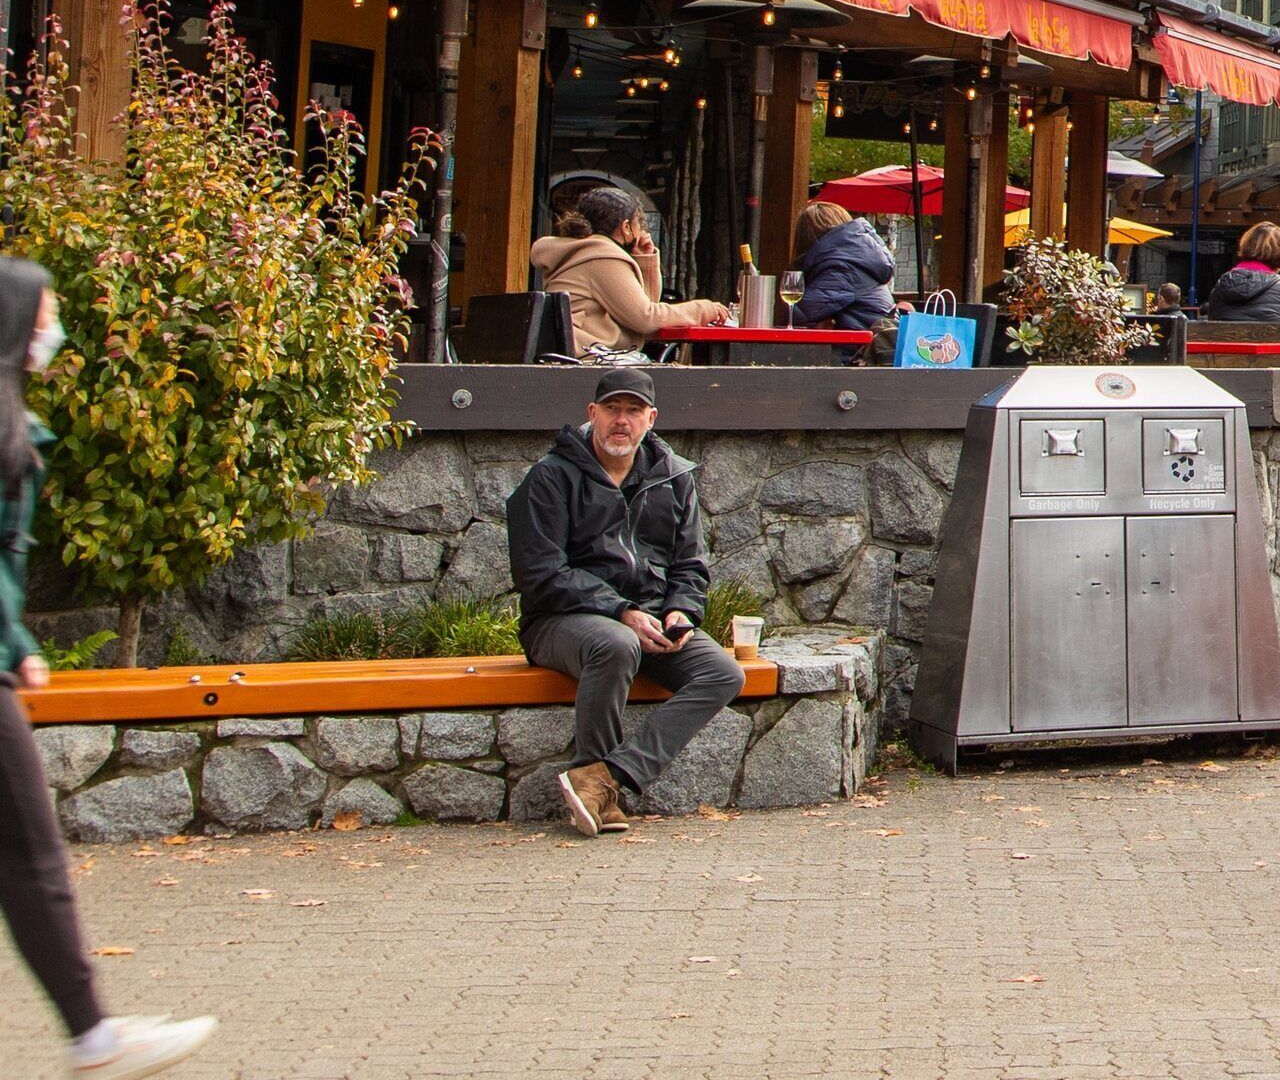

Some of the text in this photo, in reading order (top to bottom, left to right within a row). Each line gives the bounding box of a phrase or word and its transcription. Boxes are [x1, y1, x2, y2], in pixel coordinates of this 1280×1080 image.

[1029, 498, 1100, 511] Garbage Only
[1150, 497, 1216, 510] Recycle Only
